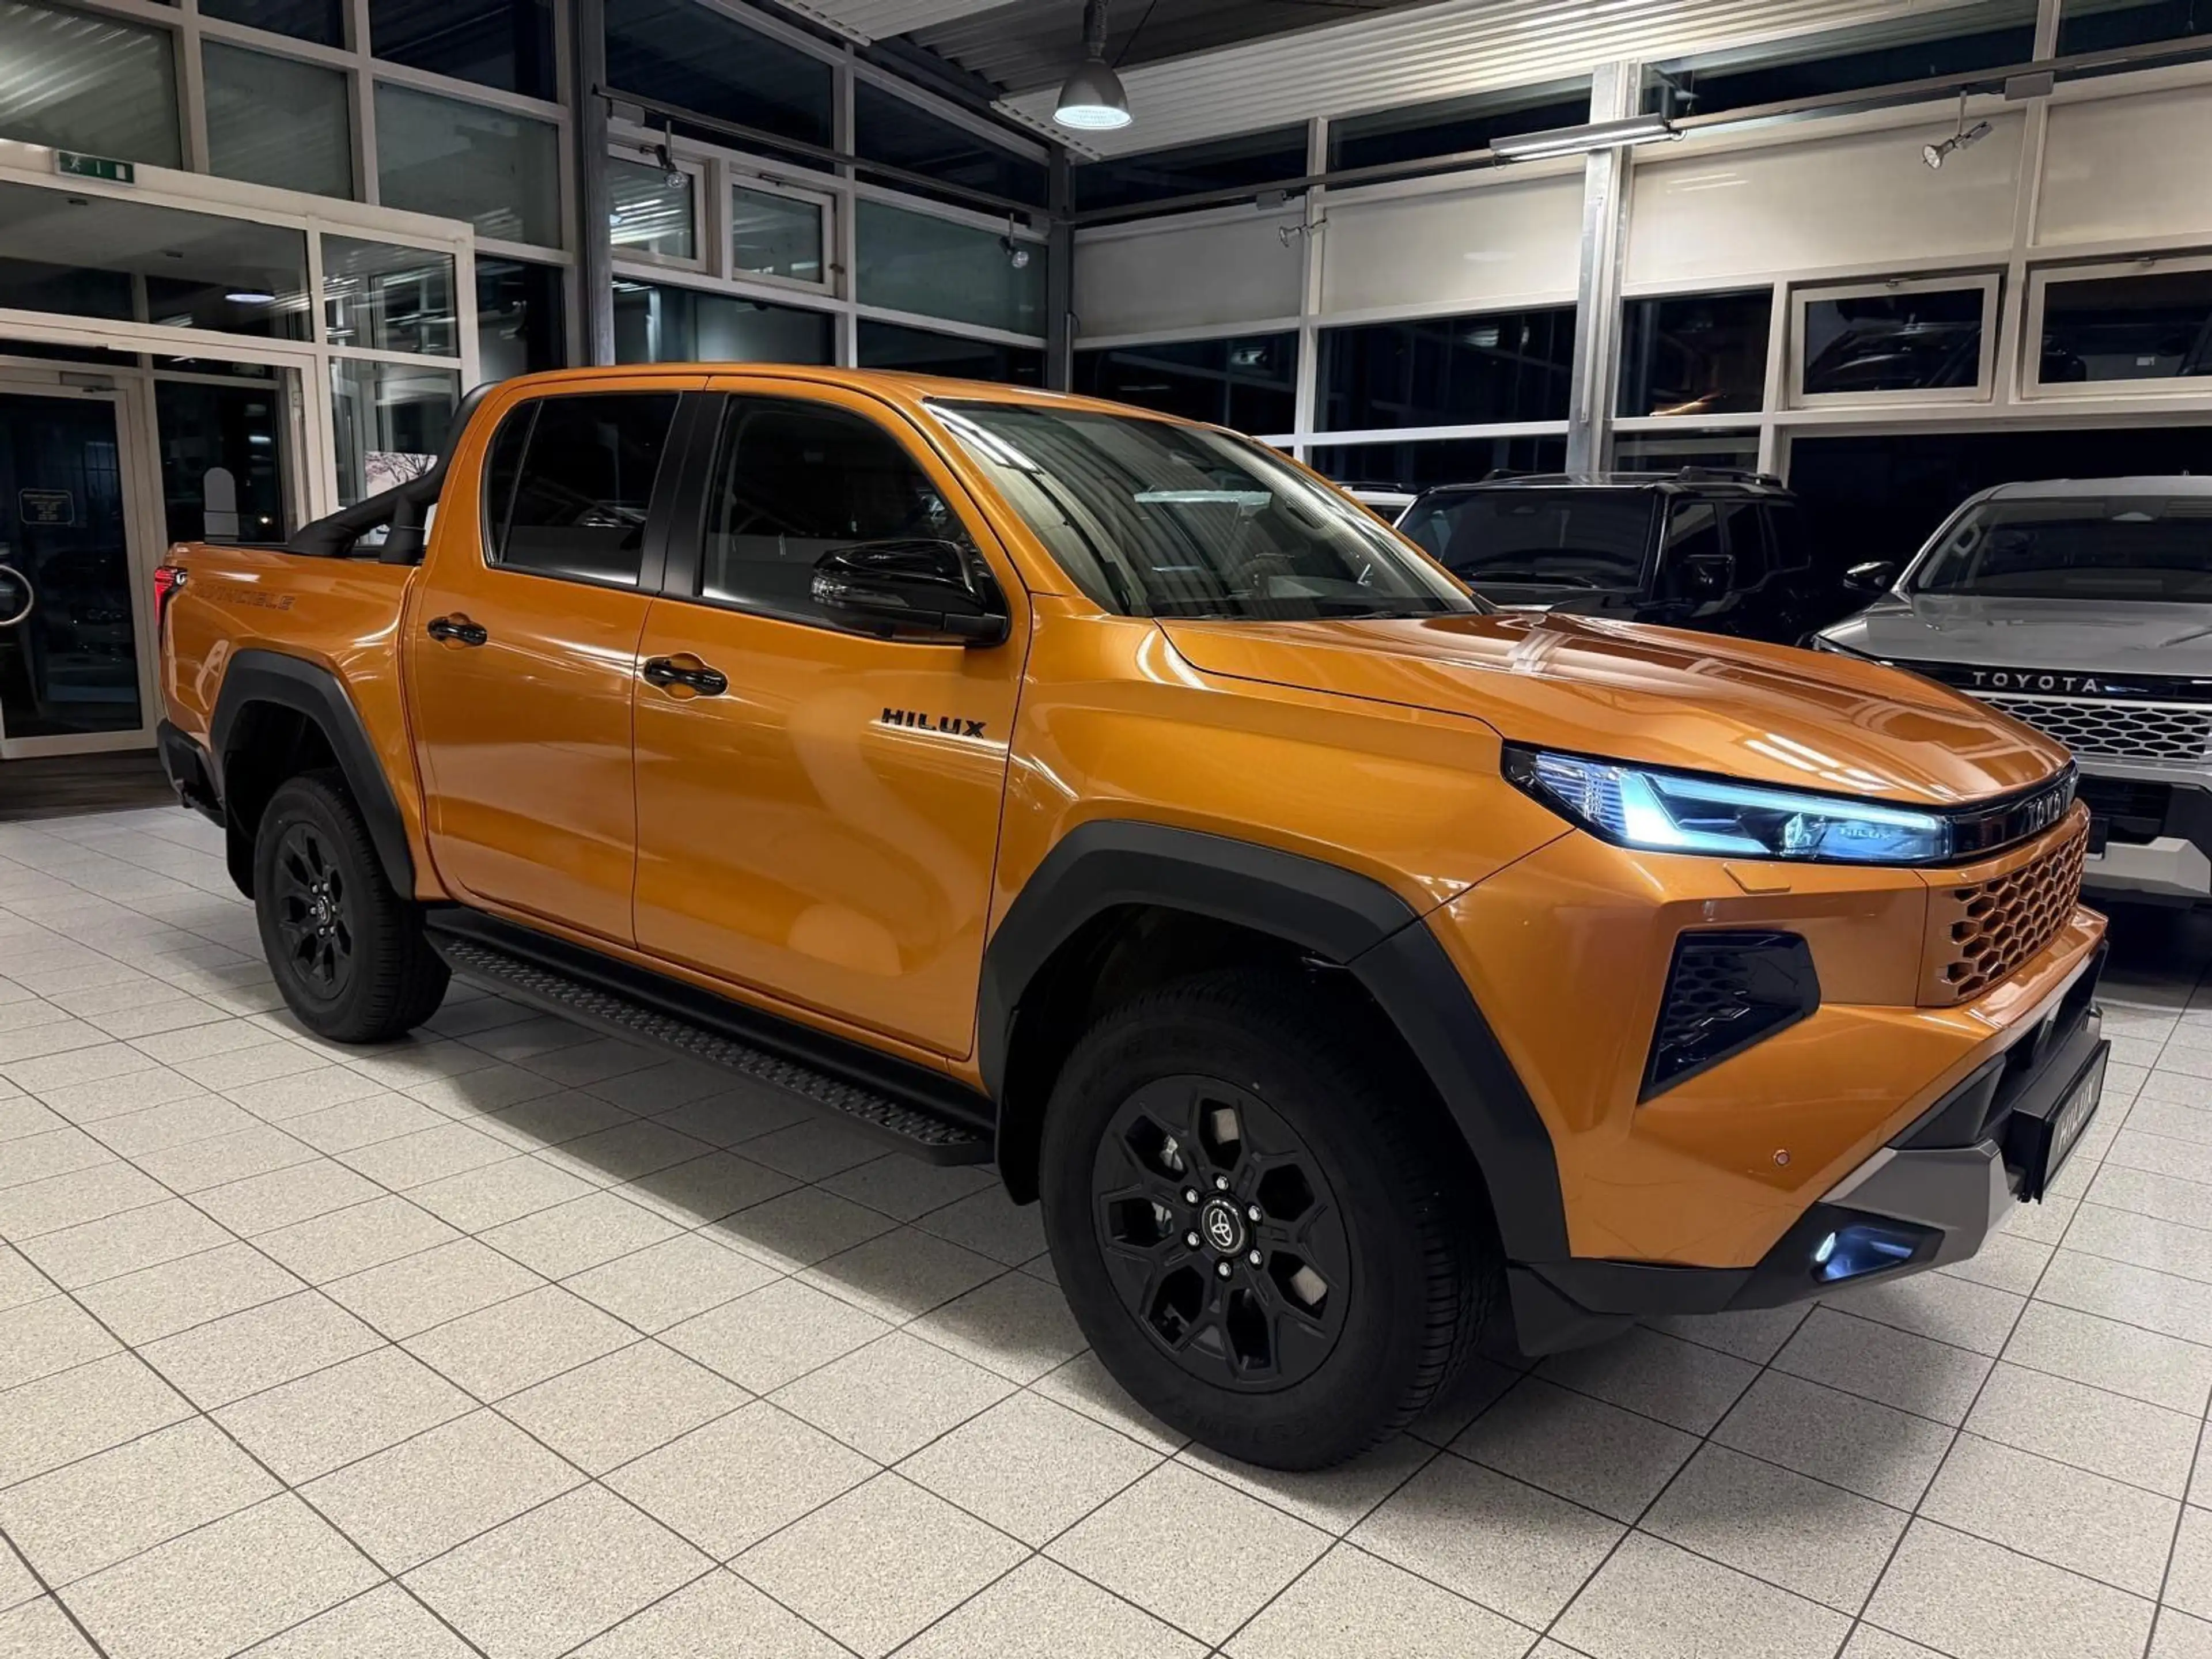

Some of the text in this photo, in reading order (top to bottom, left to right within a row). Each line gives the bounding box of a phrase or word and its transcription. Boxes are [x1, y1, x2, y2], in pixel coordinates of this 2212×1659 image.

[1973, 671, 2099, 692] TOYOTA
[881, 707, 987, 739] HILUX
[2023, 785, 2069, 831] TOYOT
[2056, 1075, 2096, 1154] HILUX
